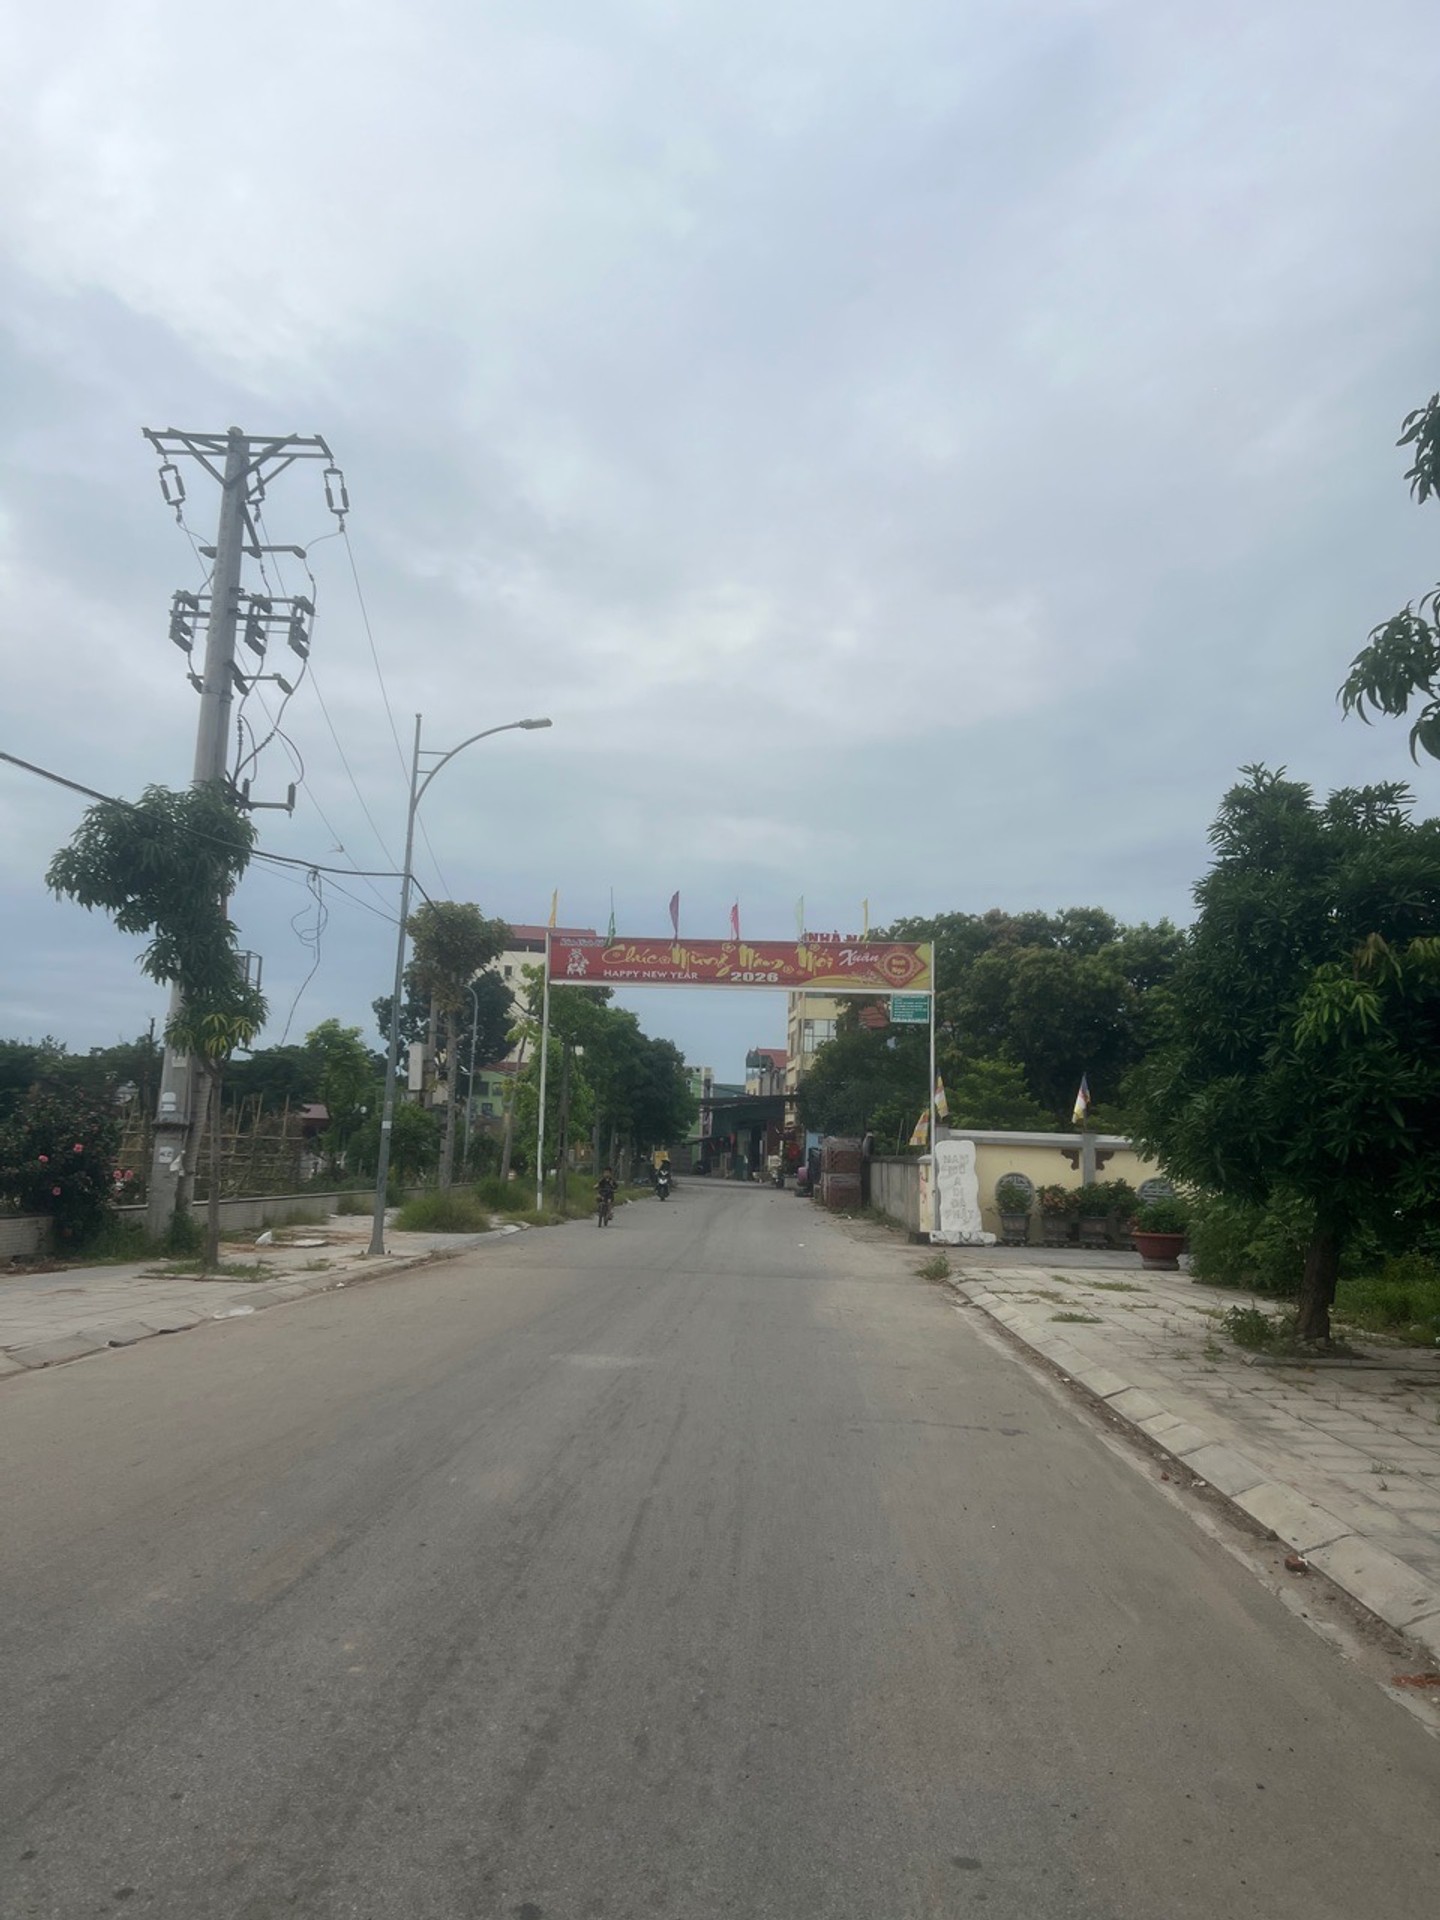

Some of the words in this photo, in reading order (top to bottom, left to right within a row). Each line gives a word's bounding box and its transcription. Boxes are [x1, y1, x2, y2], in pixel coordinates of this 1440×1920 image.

[808, 929, 841, 942] NHÀ
[602, 944, 659, 964] Chúc
[667, 942, 735, 977] Mừng
[739, 944, 784, 970] Năm
[795, 943, 833, 976] Mới
[839, 949, 879, 966] Xuân
[603, 970, 639, 978] HAPPY
[642, 971, 669, 979] NEW
[670, 972, 698, 980] YEAR
[730, 972, 779, 982] 2026
